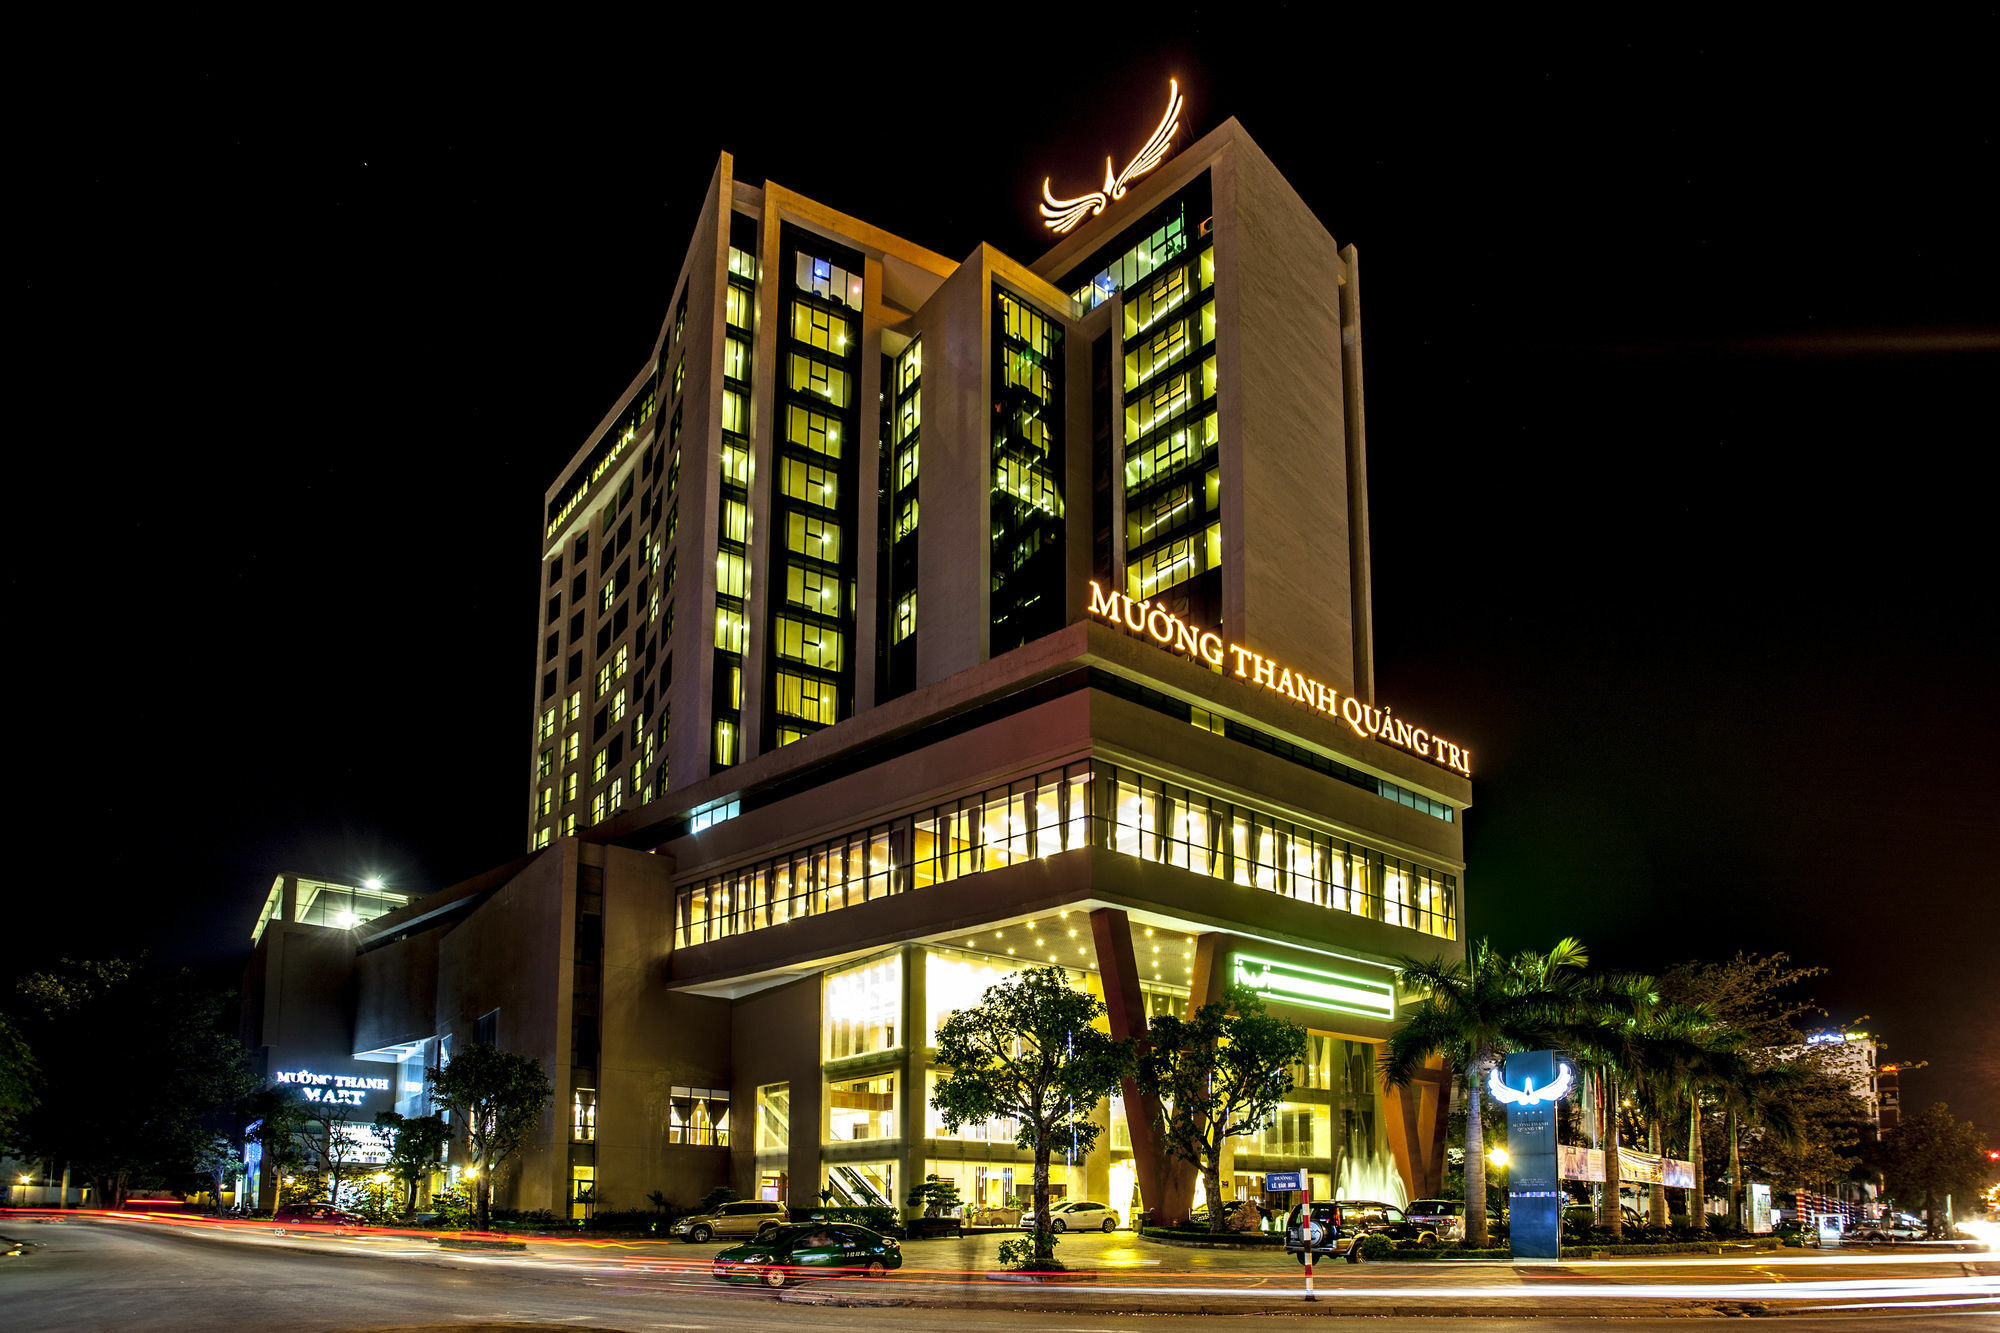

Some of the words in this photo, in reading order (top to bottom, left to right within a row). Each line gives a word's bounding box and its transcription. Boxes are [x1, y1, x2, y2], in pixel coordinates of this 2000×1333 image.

[1088, 581, 1224, 666] MƯỜNG
[1230, 642, 1338, 717] THANH
[1343, 697, 1429, 755] QUẢNG
[335, 1076, 389, 1090] THANH
[303, 1088, 365, 1105] MART
